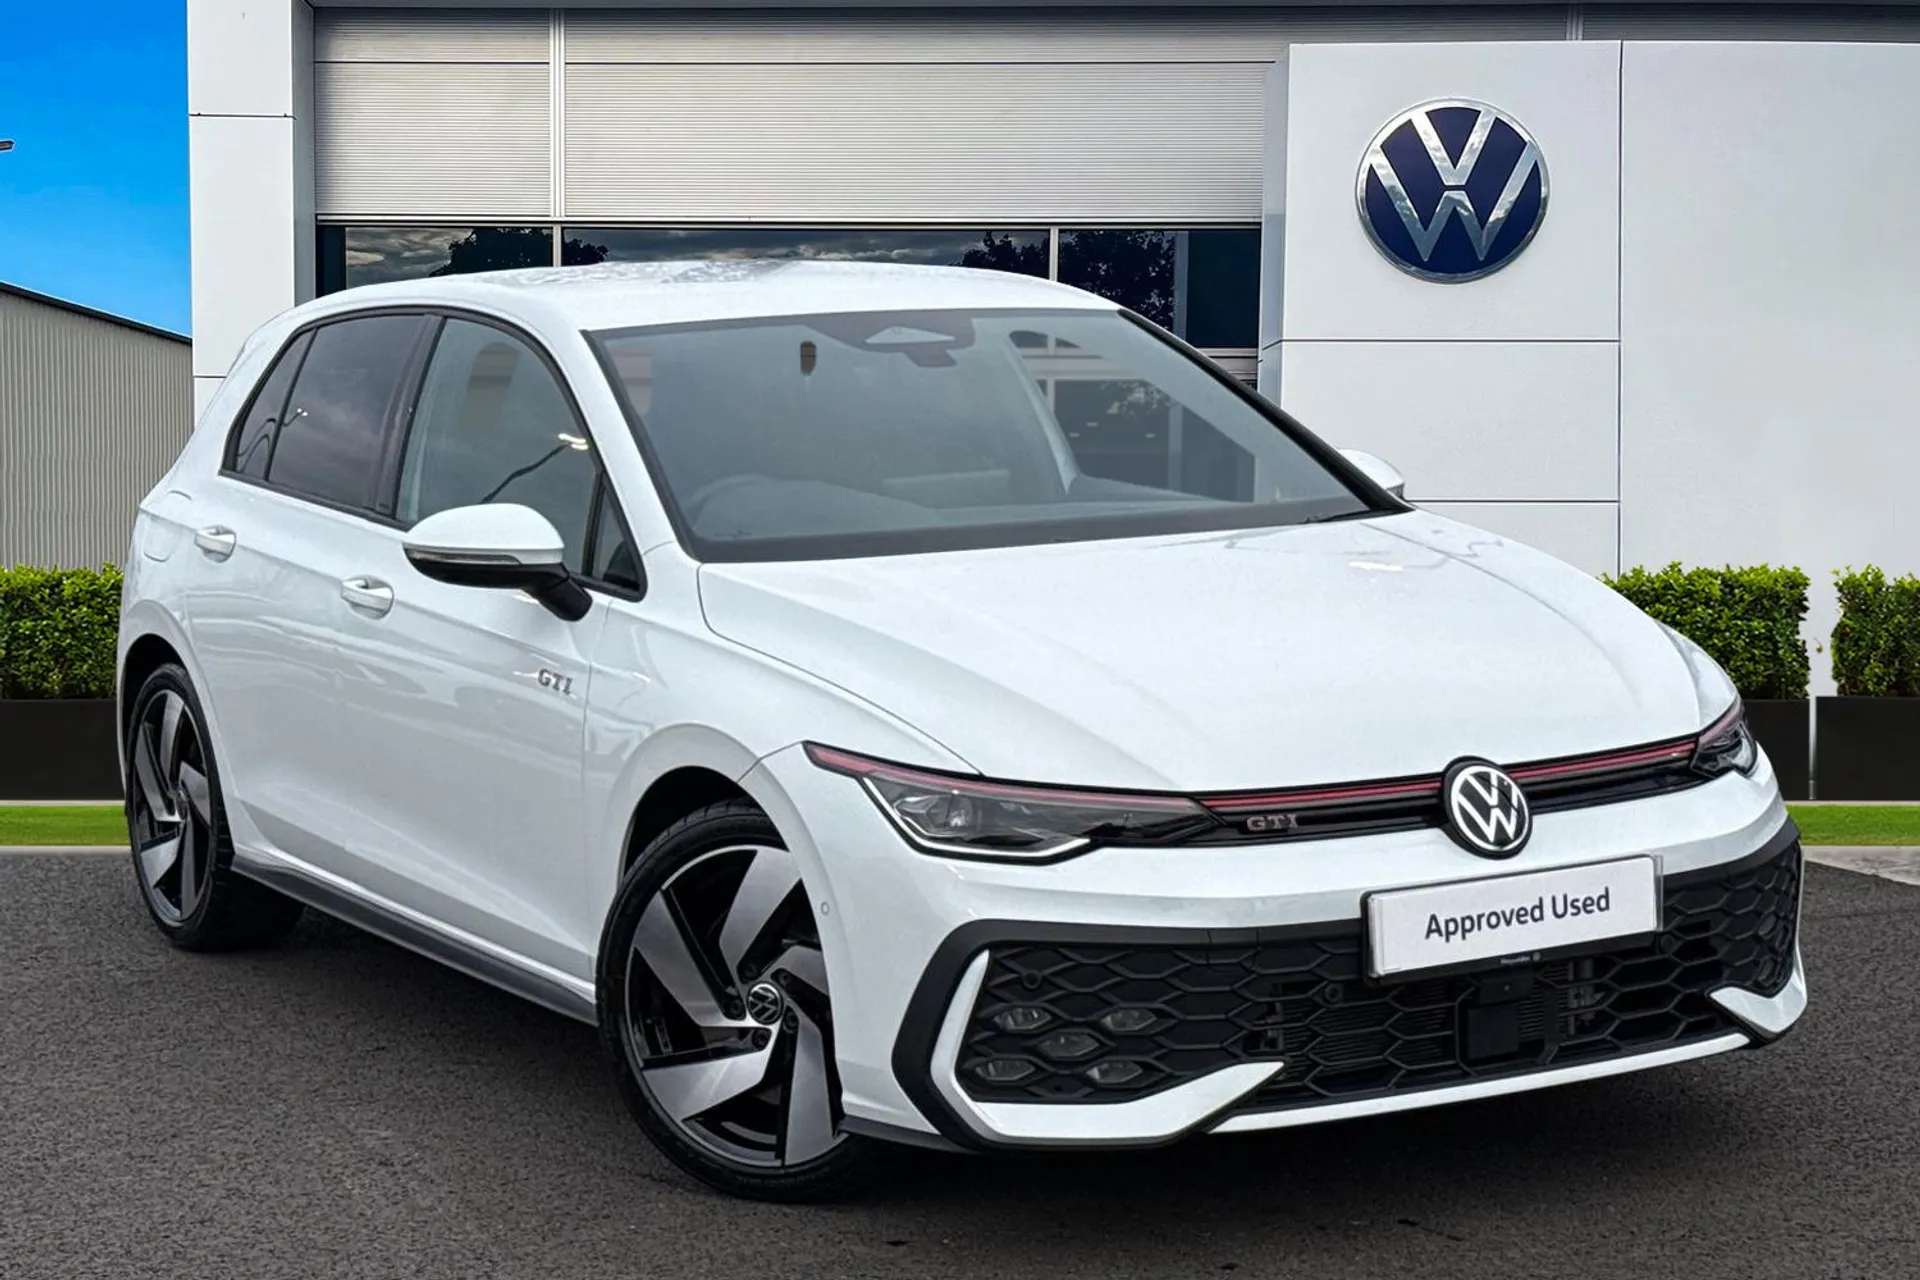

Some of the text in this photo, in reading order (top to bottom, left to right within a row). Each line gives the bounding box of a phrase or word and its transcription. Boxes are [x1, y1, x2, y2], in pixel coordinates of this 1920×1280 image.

[537, 668, 573, 696] GTI
[1246, 813, 1300, 832] GTI
[1425, 886, 1611, 943] Approved Used
